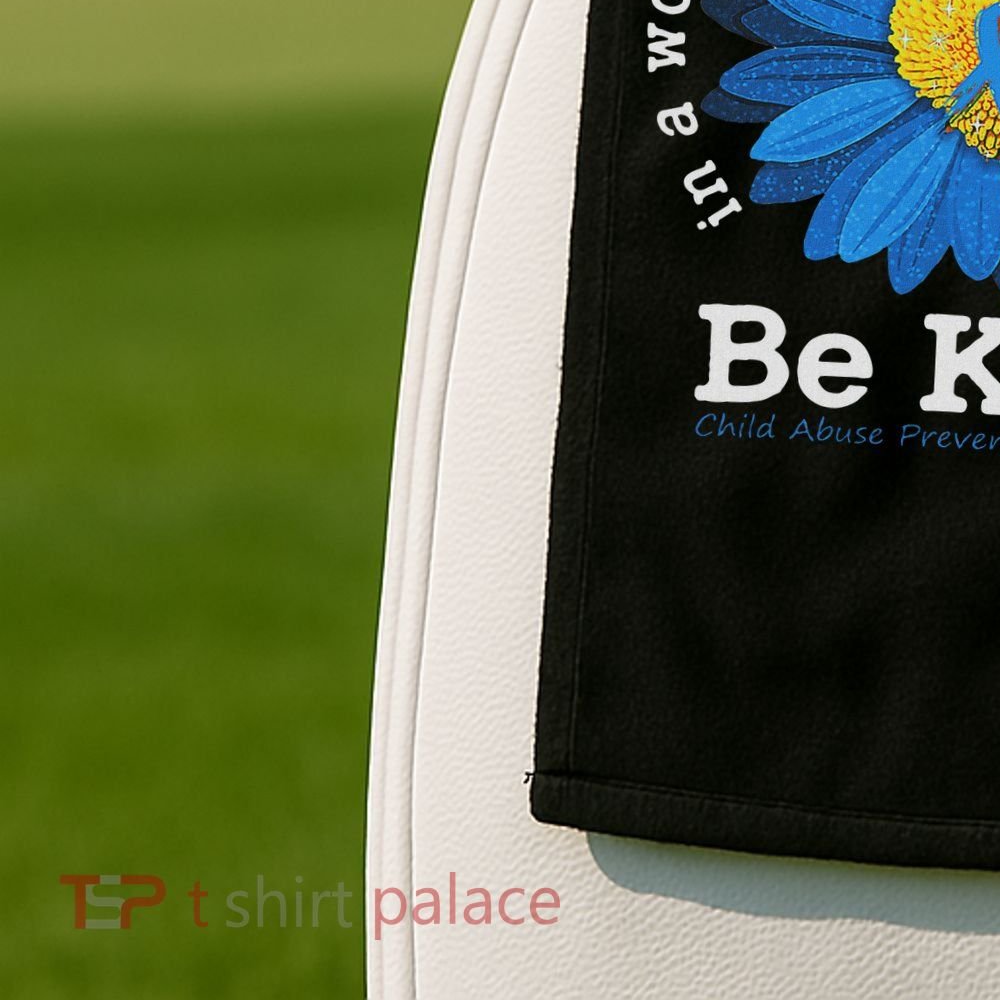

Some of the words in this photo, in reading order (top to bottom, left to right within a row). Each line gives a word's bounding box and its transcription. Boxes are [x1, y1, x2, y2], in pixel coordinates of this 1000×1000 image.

[656, 101, 699, 137] a
[683, 159, 743, 231] in
[694, 303, 874, 409] Be
[695, 412, 776, 440] Child
[789, 416, 884, 445] Abuse
